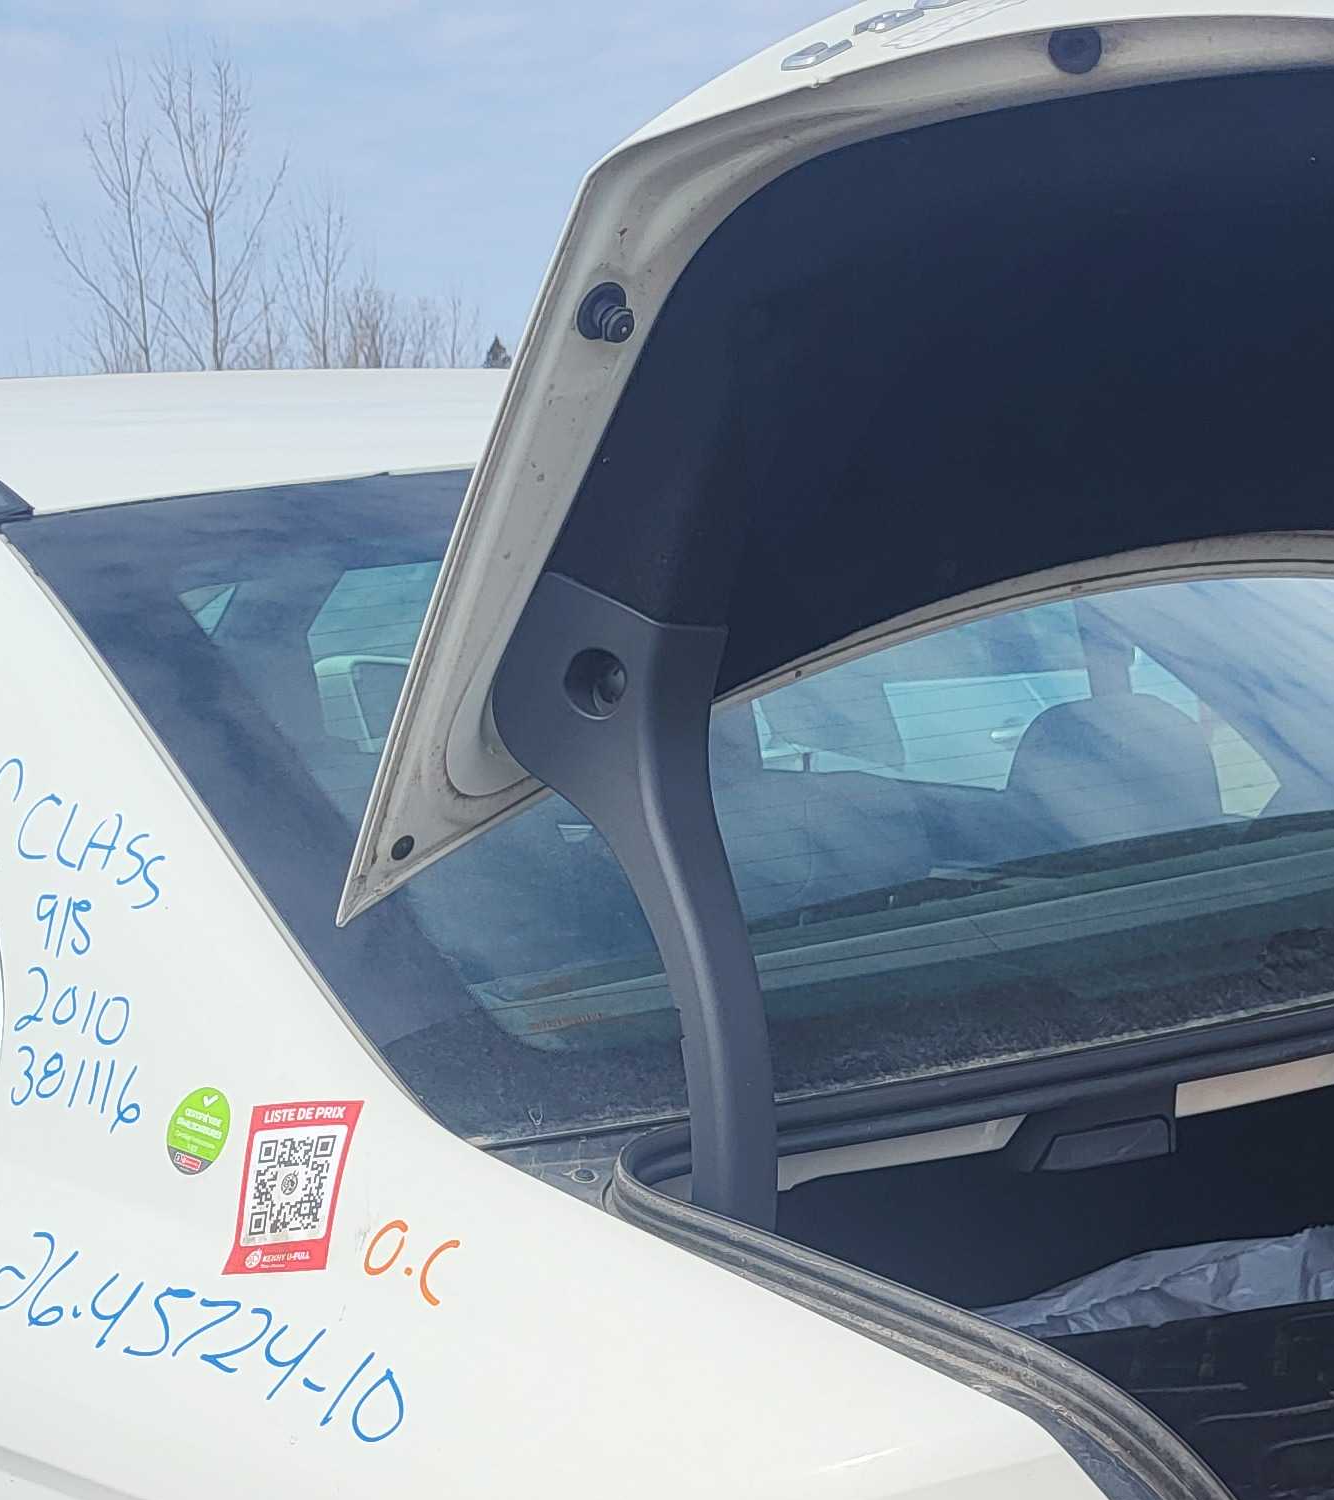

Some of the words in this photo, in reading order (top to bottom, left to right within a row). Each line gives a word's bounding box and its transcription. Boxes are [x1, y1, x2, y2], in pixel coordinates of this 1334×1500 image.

[14, 966, 130, 1045] 2010
[10, 1045, 141, 1135] 381116
[264, 1108, 296, 1124] LISTE
[297, 1107, 315, 1121] DE
[315, 1105, 346, 1120] PRIX
